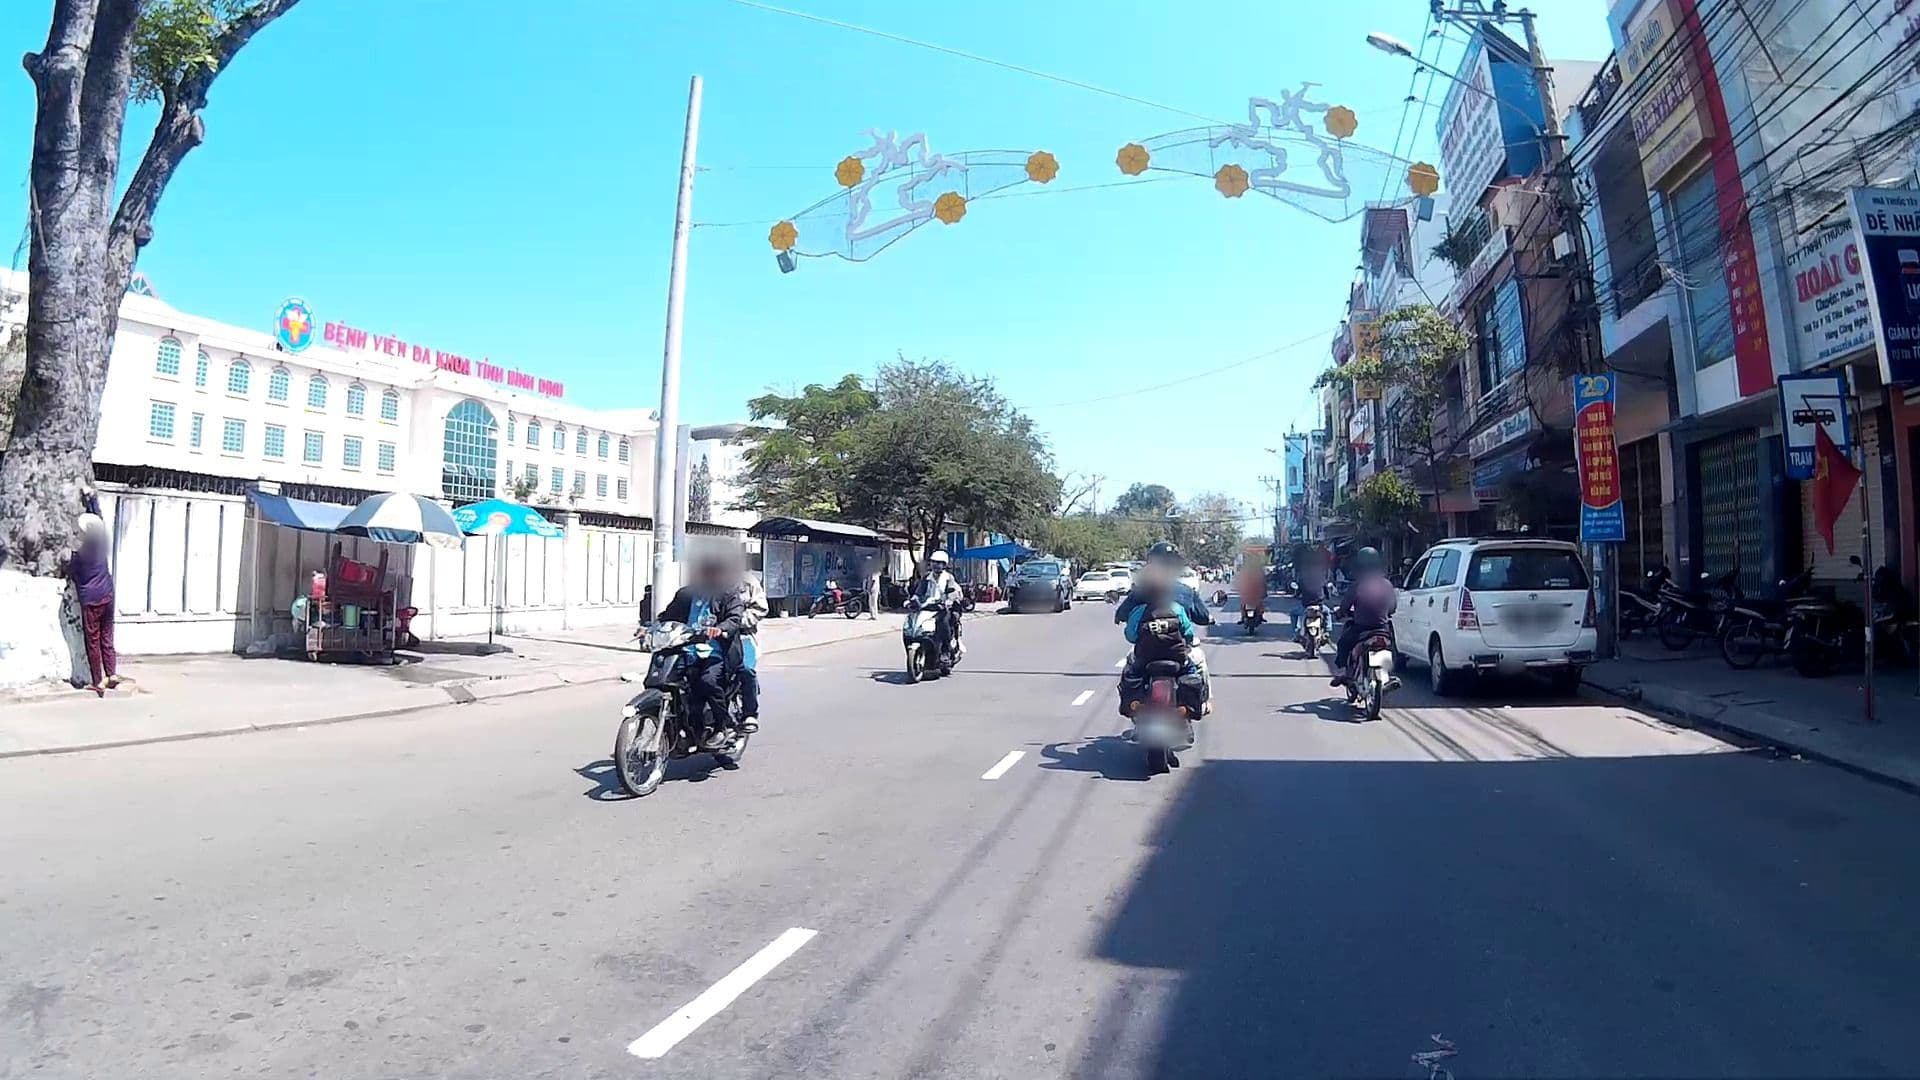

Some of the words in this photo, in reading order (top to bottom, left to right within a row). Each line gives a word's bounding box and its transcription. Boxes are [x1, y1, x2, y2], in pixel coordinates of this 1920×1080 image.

[324, 320, 368, 351] BỆNH
[374, 333, 407, 358] VIỆN
[412, 344, 431, 365] ĐA
[436, 350, 471, 376] KHOA
[475, 357, 504, 383] TỈNH
[507, 367, 534, 390] BÌNH
[539, 378, 564, 398] ĐỊNH
[1580, 376, 1609, 398] 20
